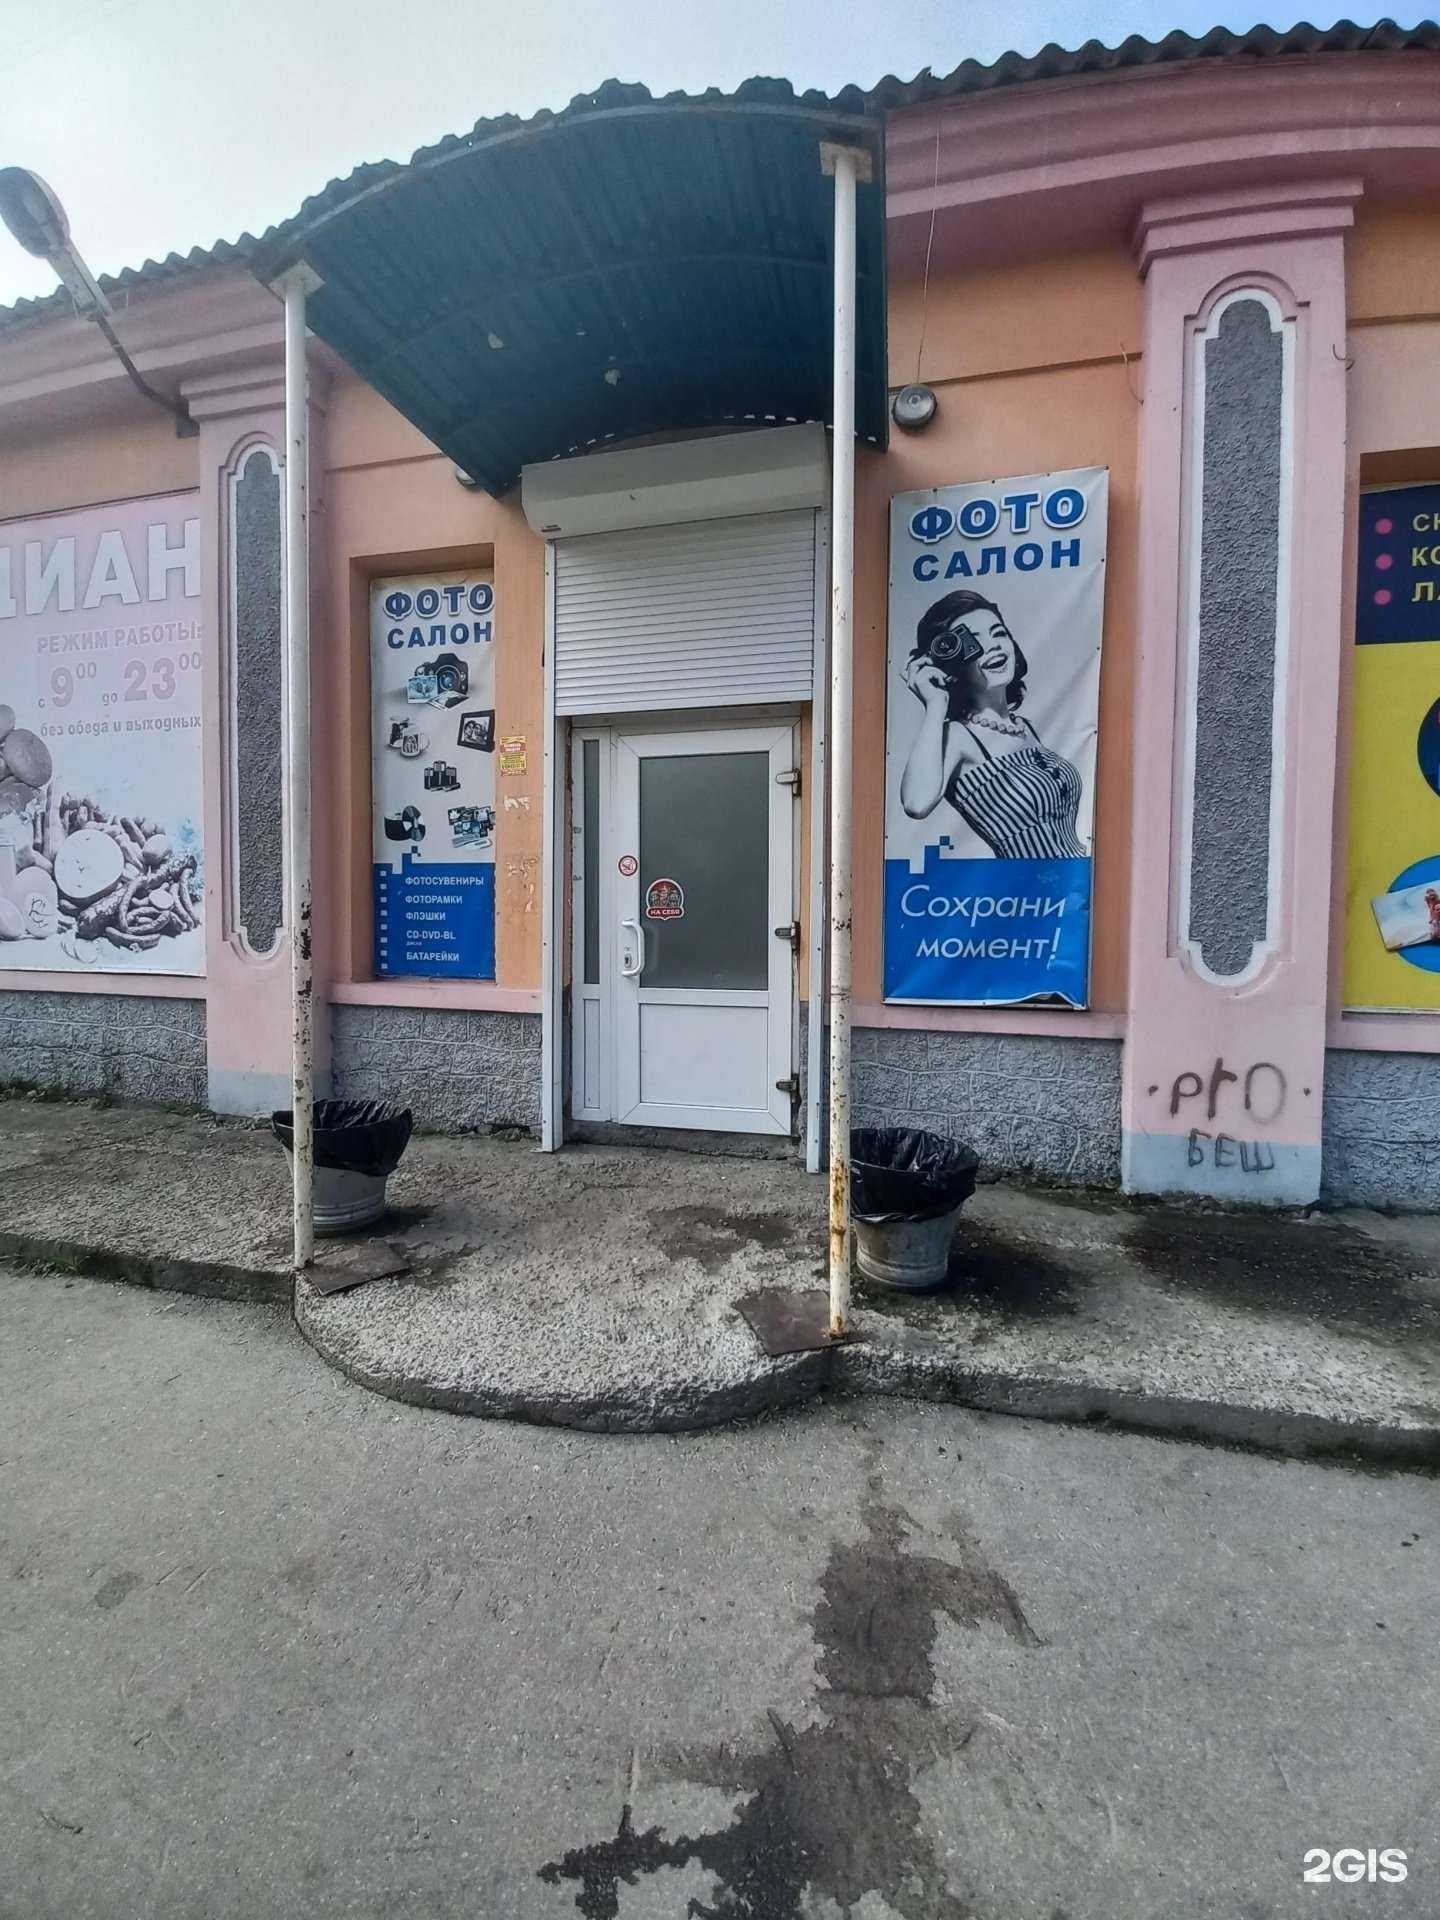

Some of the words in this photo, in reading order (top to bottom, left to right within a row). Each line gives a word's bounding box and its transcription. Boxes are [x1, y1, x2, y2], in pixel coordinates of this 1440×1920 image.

[910, 487, 1087, 544] ФОТО
[912, 538, 1081, 582] САЛОН
[384, 583, 495, 620] ФОТО
[1411, 581, 1440, 602] Л
[37, 629, 109, 653] РЕЖИМ
[387, 621, 492, 649] САЛОН
[41, 719, 64, 737] без
[68, 720, 109, 737] обеда
[126, 715, 202, 733] выходных
[405, 876, 485, 886] ФОТОСУВЕНИРЫ
[405, 895, 463, 905] ФОТОРАМКИ
[900, 884, 1067, 928] Сохрани
[405, 911, 447, 921] ФЛЭШКИ
[406, 951, 460, 961] БАТАРЕЙКИ
[915, 927, 1061, 961] момент!
